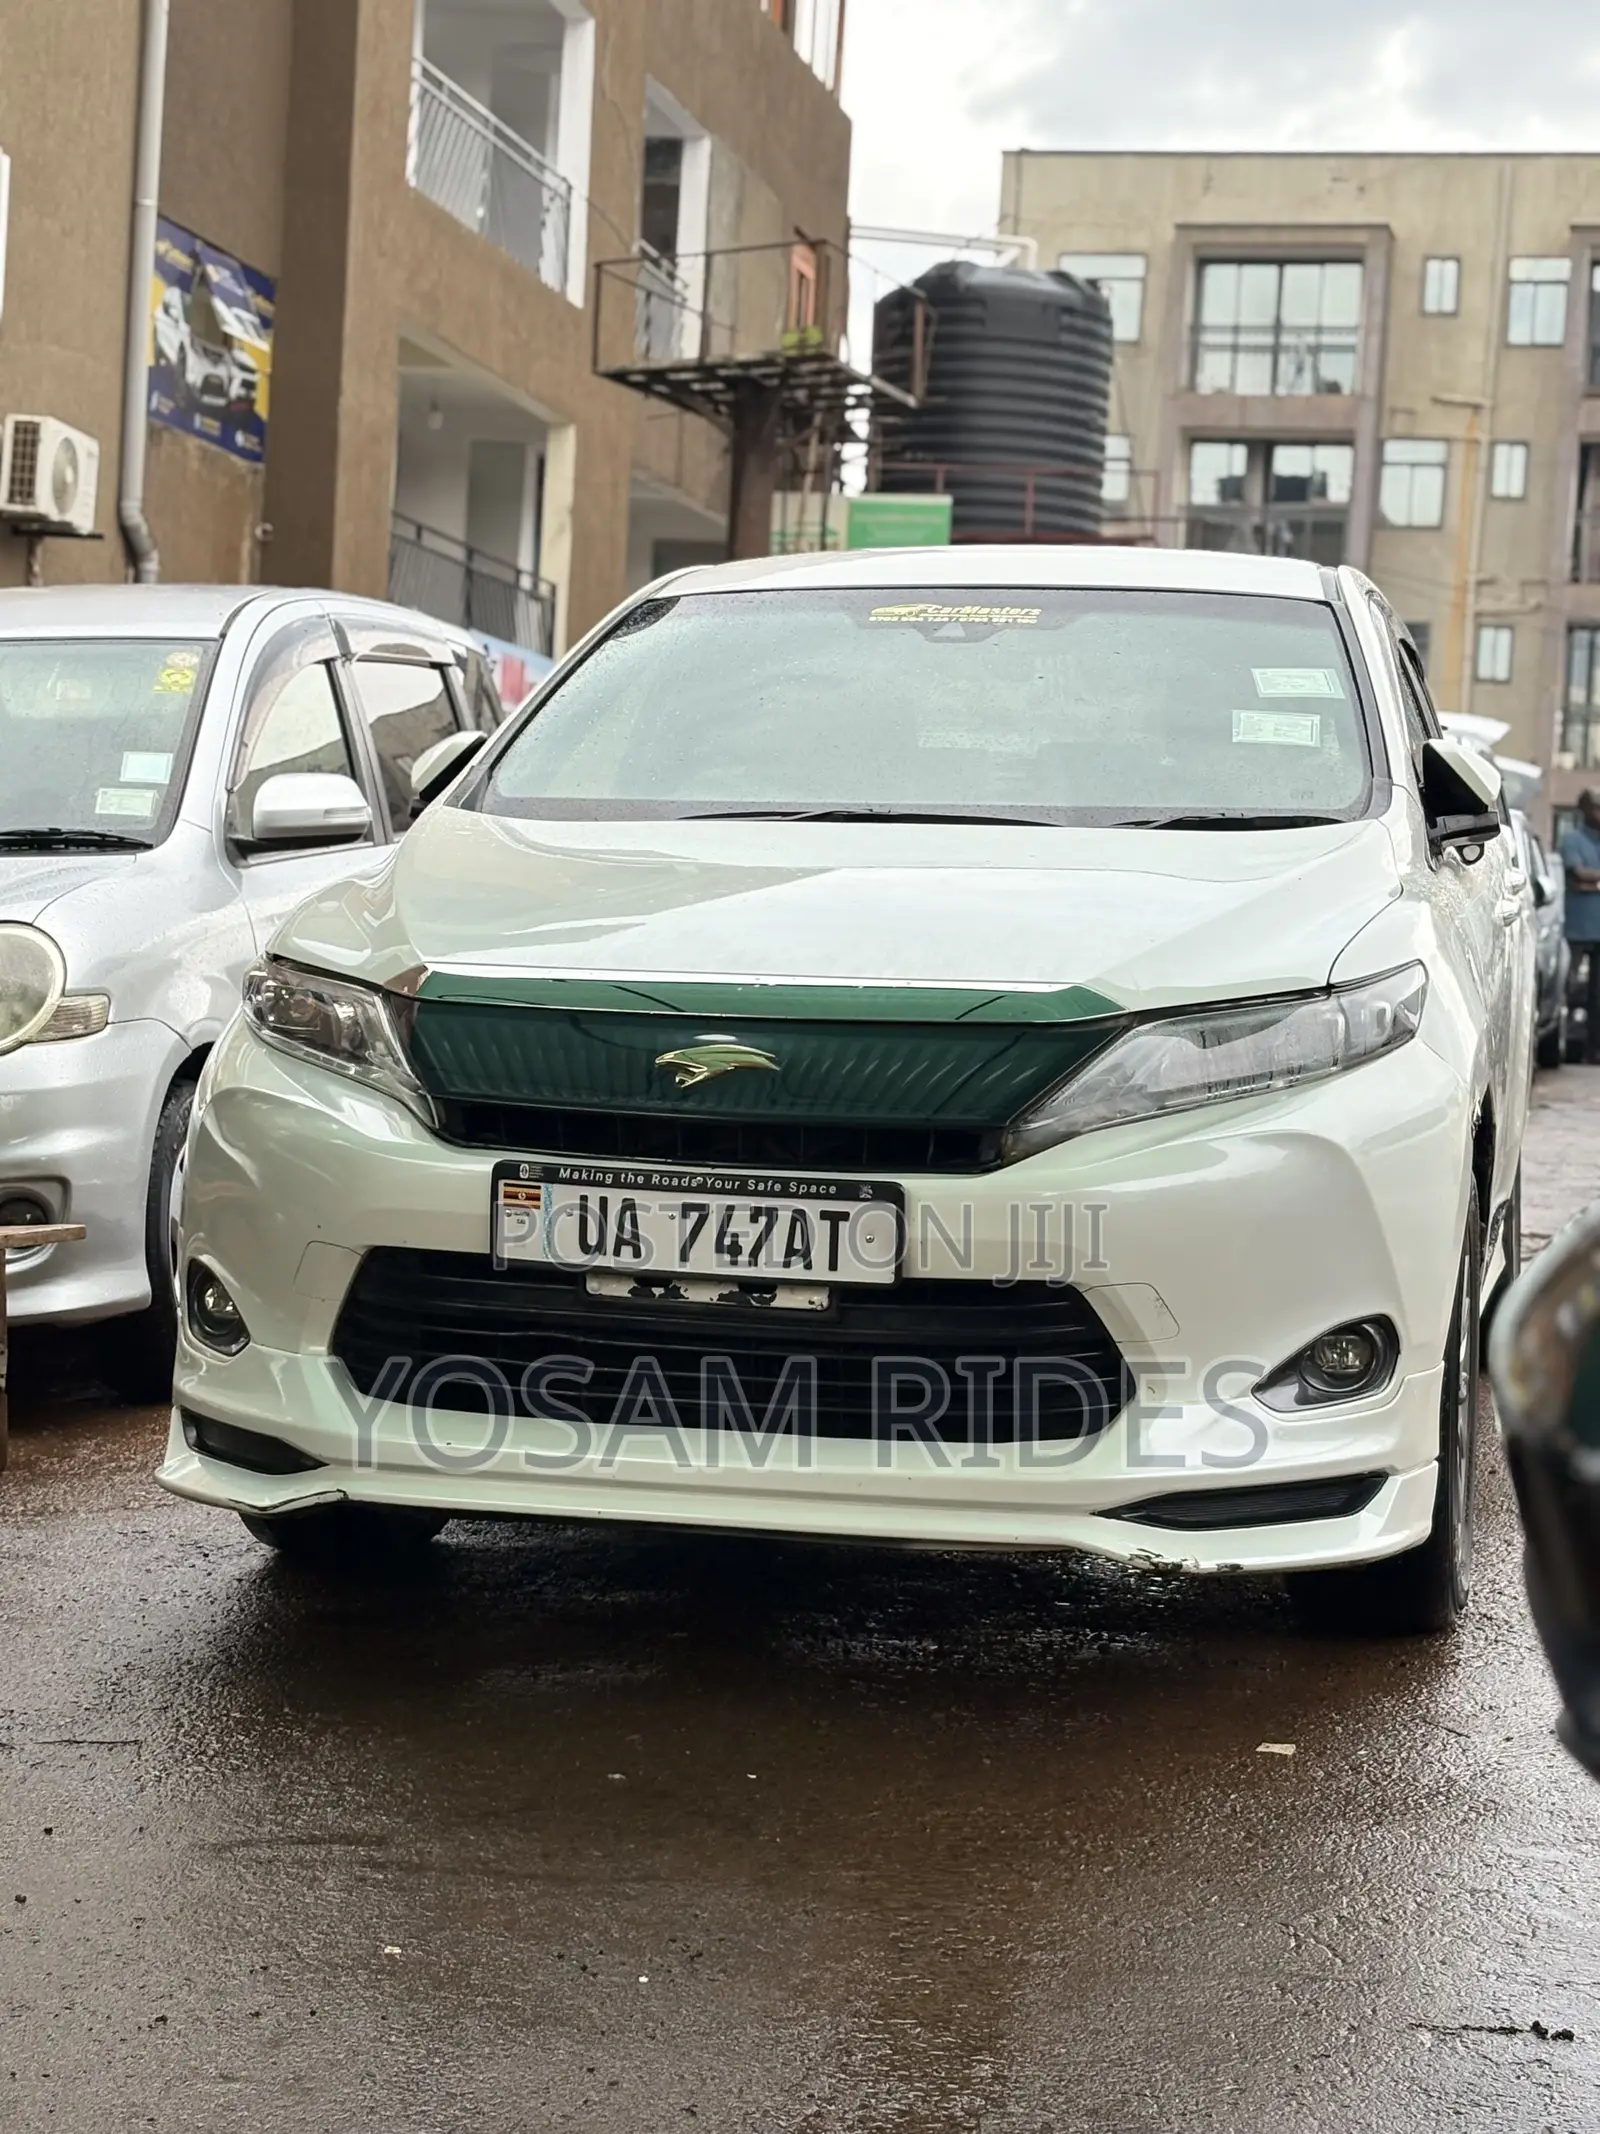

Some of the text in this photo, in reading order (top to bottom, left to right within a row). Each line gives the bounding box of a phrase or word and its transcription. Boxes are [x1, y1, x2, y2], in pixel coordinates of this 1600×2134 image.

[927, 604, 1042, 616] CarMasters
[558, 1166, 613, 1185] Making
[620, 1172, 645, 1184] the
[651, 1173, 698, 1187] Roads
[704, 1176, 741, 1189] Your
[747, 1179, 782, 1192] Safe
[788, 1181, 837, 1195] Space
[578, 1194, 851, 1272] UA 747AT
